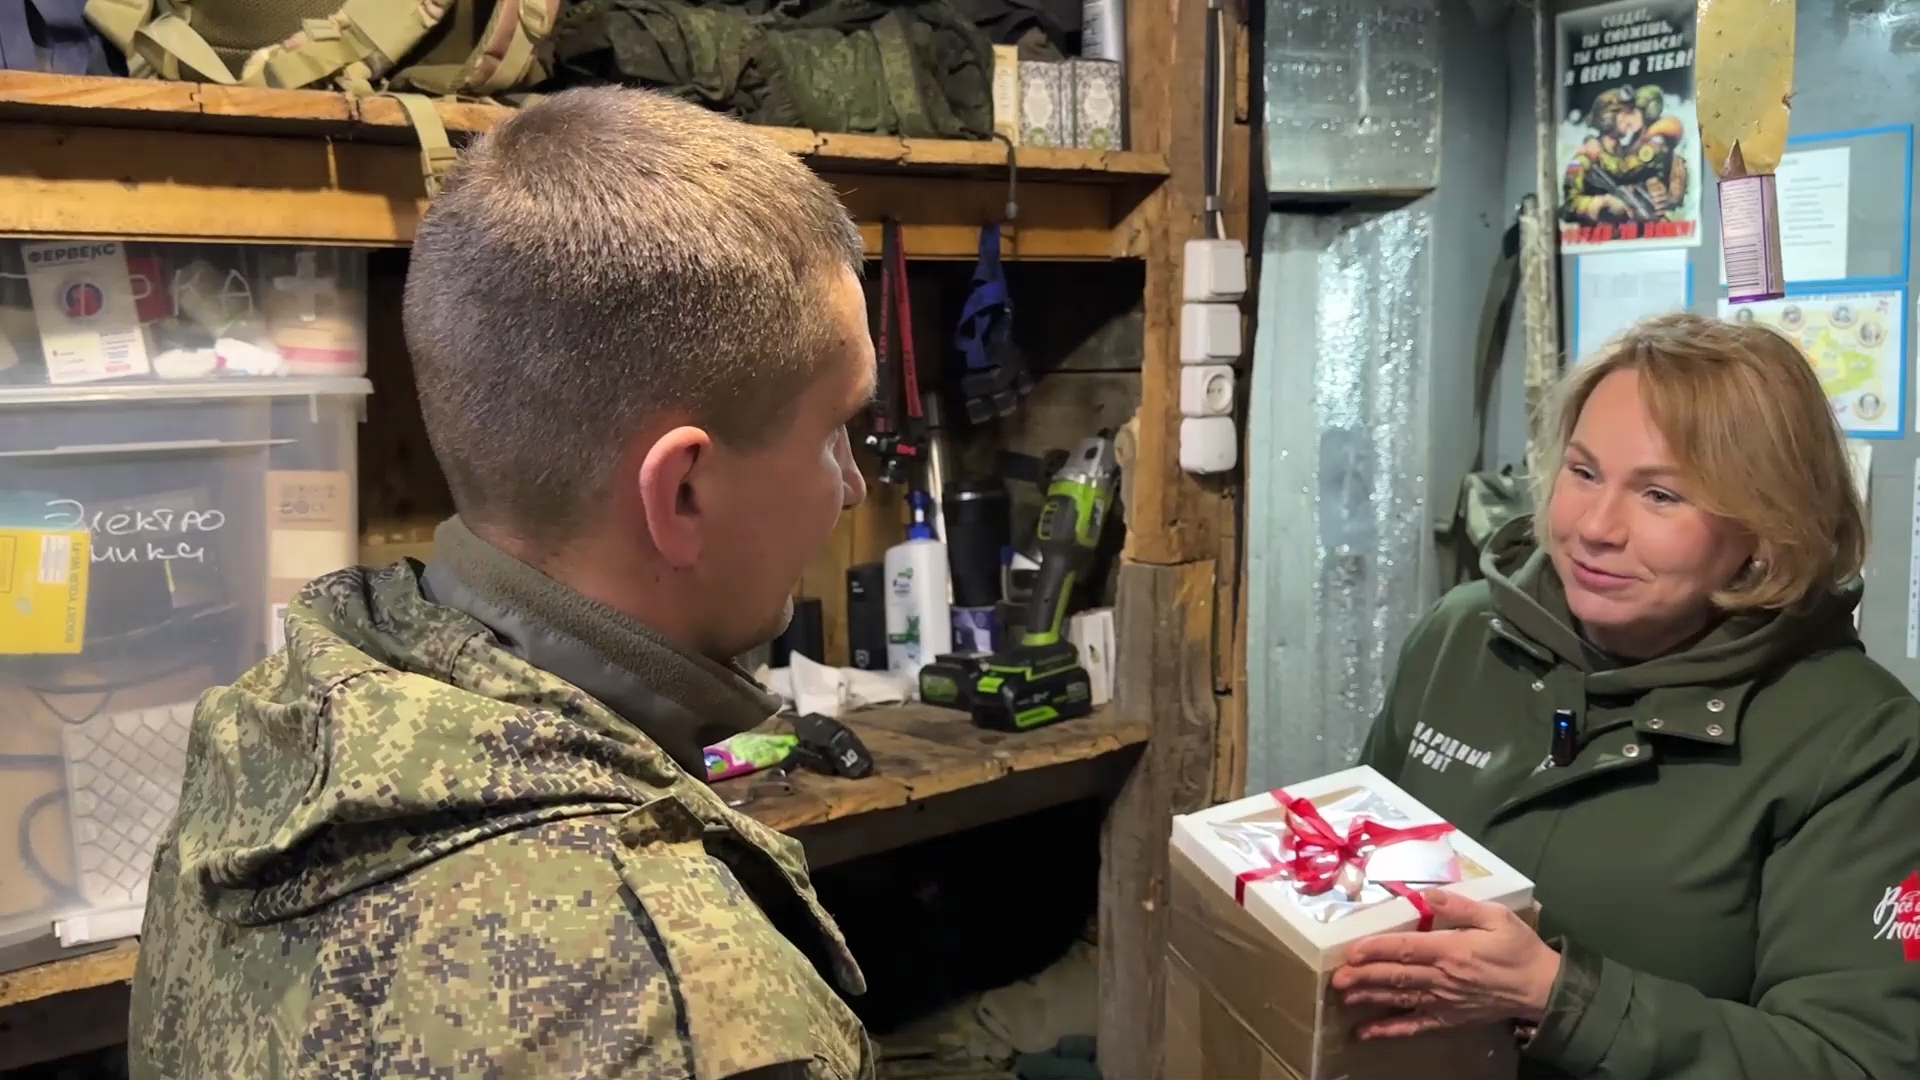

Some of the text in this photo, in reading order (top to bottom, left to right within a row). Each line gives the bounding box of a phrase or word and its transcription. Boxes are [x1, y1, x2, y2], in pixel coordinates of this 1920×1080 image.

[1582, 32, 1600, 49] ТЫ
[1573, 49, 1592, 66] ТЫ
[1580, 60, 1622, 84] ВЕРЮ
[1628, 57, 1640, 76] В
[1647, 47, 1695, 73] ТЕБЯ!
[25, 243, 116, 264] ФЕРВЕКС
